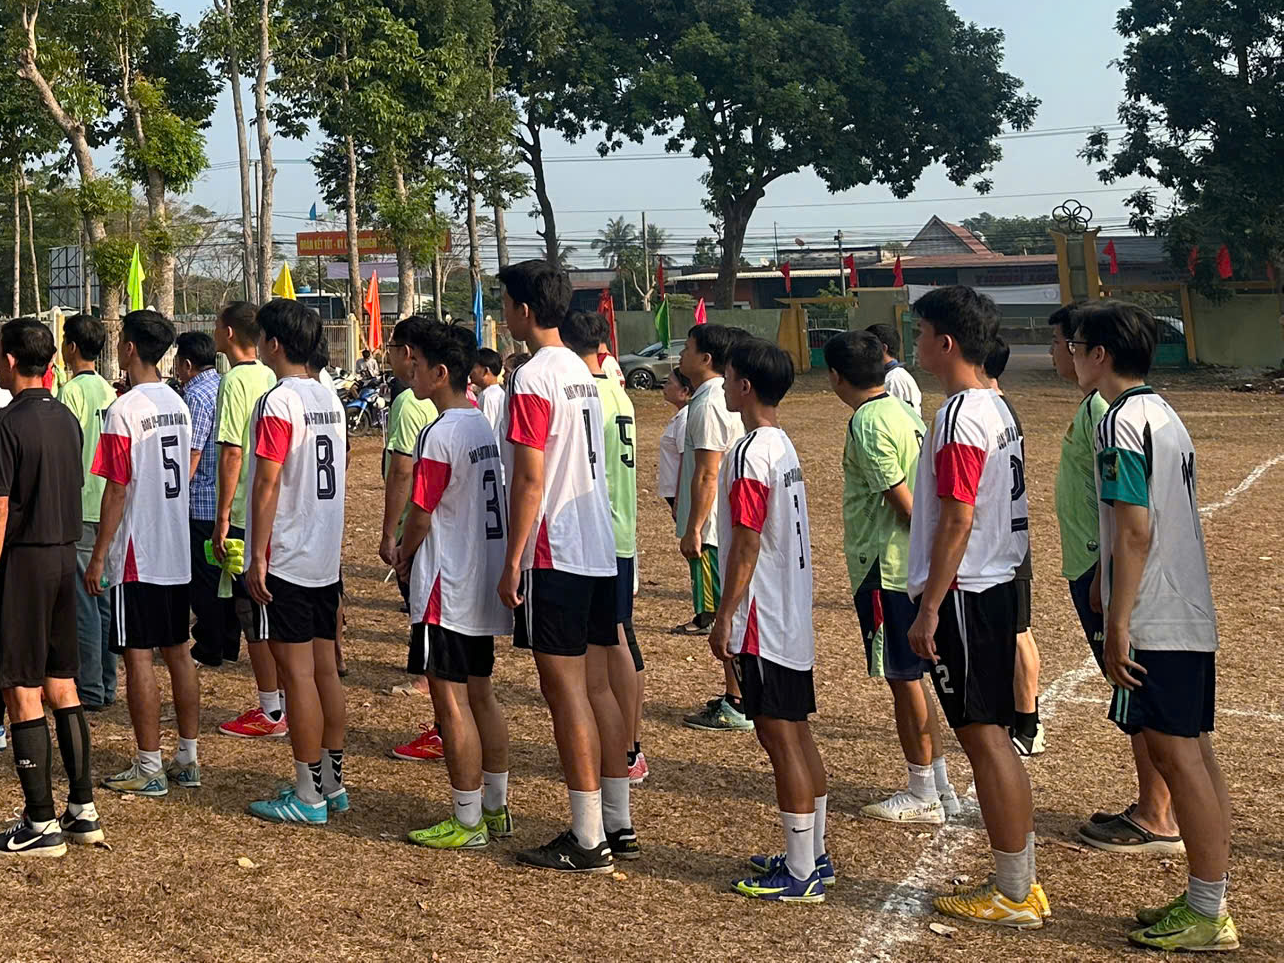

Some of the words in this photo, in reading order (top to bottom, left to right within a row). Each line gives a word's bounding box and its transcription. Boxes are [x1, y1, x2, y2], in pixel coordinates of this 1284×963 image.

[160, 435, 181, 499] 5
[316, 434, 336, 500] 8
[615, 415, 635, 469] 5
[482, 469, 504, 541] 3
[935, 664, 955, 694] 2
